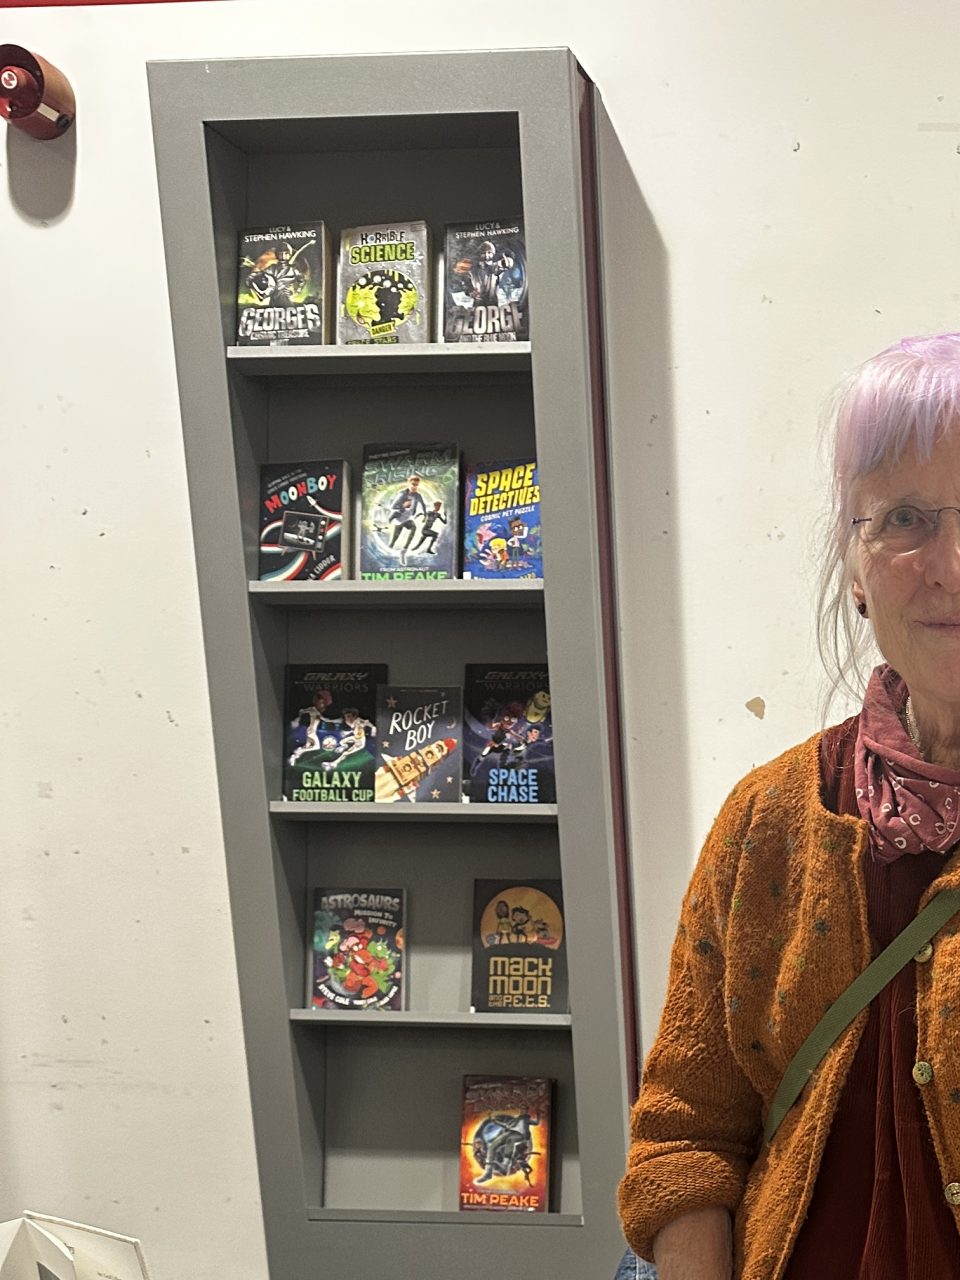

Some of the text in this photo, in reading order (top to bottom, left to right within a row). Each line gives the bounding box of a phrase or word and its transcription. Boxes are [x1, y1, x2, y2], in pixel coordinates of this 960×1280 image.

[244, 230, 316, 242] STEPHEN HAWKING
[361, 230, 405, 245] HORRIBLE
[456, 226, 520, 240] STEPHEN HAWKING
[350, 242, 415, 264] SCIENCE
[446, 302, 522, 338] GEORGE
[475, 463, 536, 496] SPACE
[264, 474, 336, 514] MOONBOY
[469, 486, 540, 516] DETECTIVES
[480, 505, 536, 522] COSMIC PET PUZZLE
[362, 572, 389, 580] TIM
[304, 672, 369, 681] GALAXY
[389, 700, 449, 735] ROCKET
[404, 721, 436, 752] BOY
[302, 772, 362, 788] GALAXY
[488, 768, 538, 786] SPACE
[292, 788, 374, 802] FOOTBALL CUP
[488, 786, 539, 802] CHASE
[320, 894, 400, 910] ASTROSAURS
[461, 1193, 488, 1205] TIM
[489, 1194, 540, 1208] PEAKE
